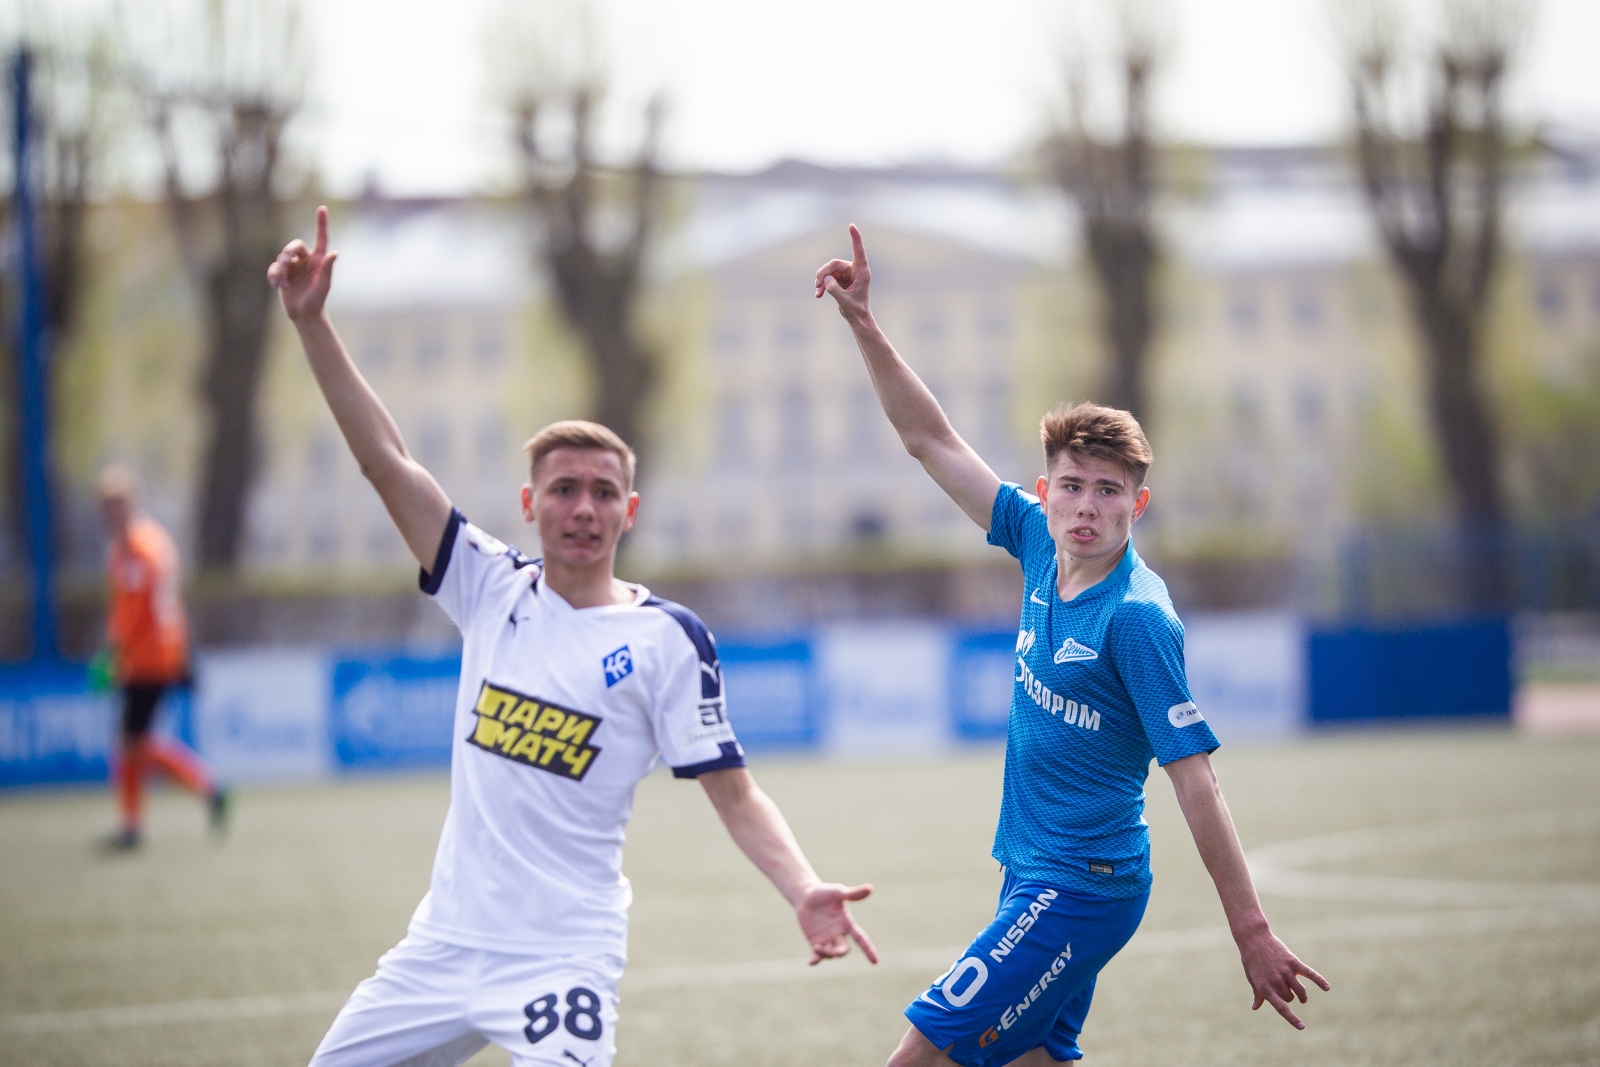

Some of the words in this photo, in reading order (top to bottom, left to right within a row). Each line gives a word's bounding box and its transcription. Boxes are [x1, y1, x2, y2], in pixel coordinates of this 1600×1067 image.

[474, 715, 593, 776] МАТЧ
[477, 685, 595, 746] ПАРИ
[989, 888, 1059, 964] NISSAN
[933, 945, 988, 1008] 0
[524, 986, 603, 1044] 88
